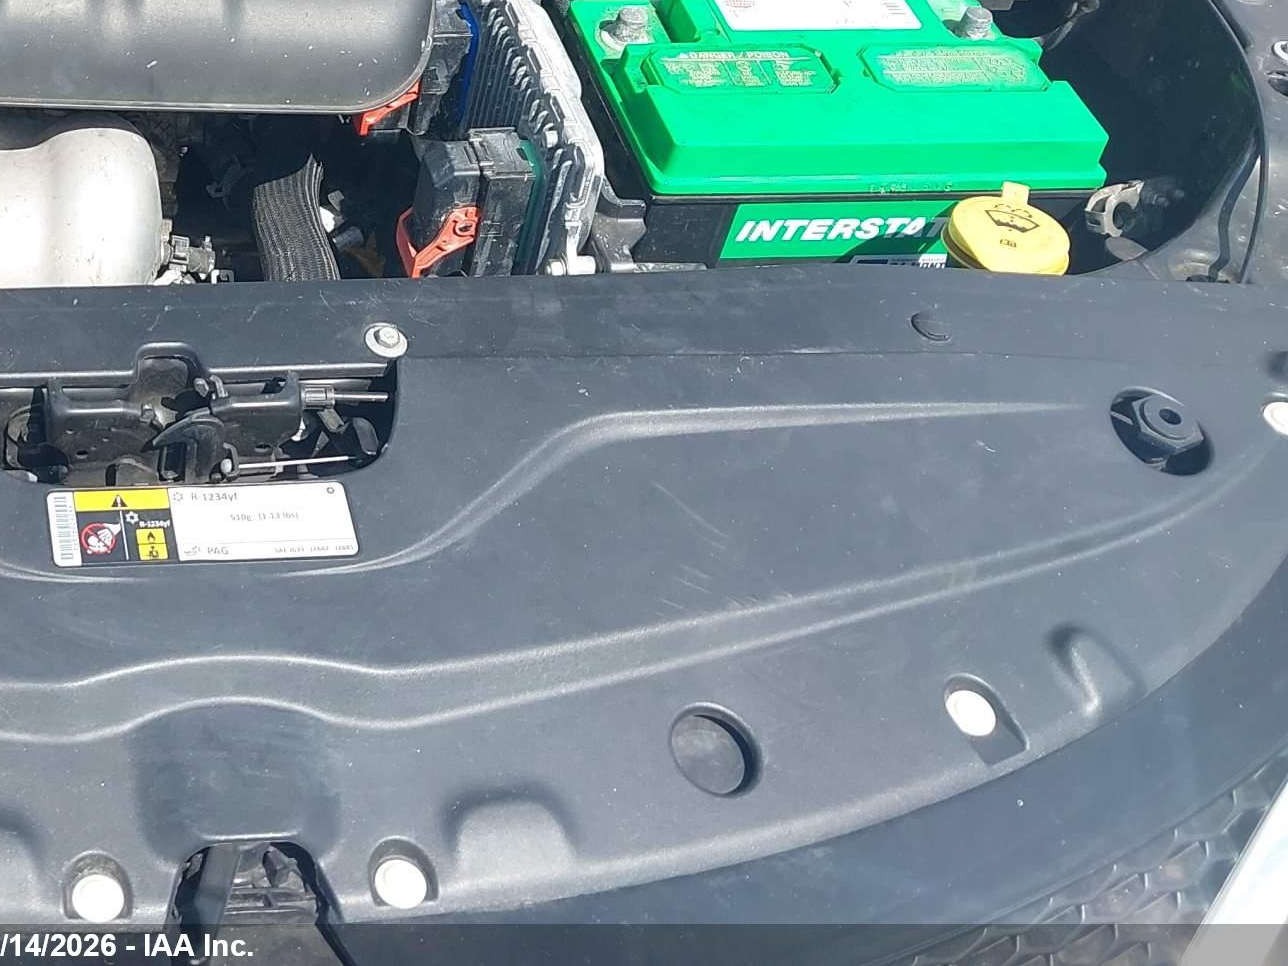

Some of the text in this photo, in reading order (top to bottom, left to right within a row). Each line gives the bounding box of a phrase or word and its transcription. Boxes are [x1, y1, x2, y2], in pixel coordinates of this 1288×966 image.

[734, 217, 950, 242] INTERSTAT
[190, 491, 238, 503] R-1234yf
[207, 546, 229, 556] PAG
